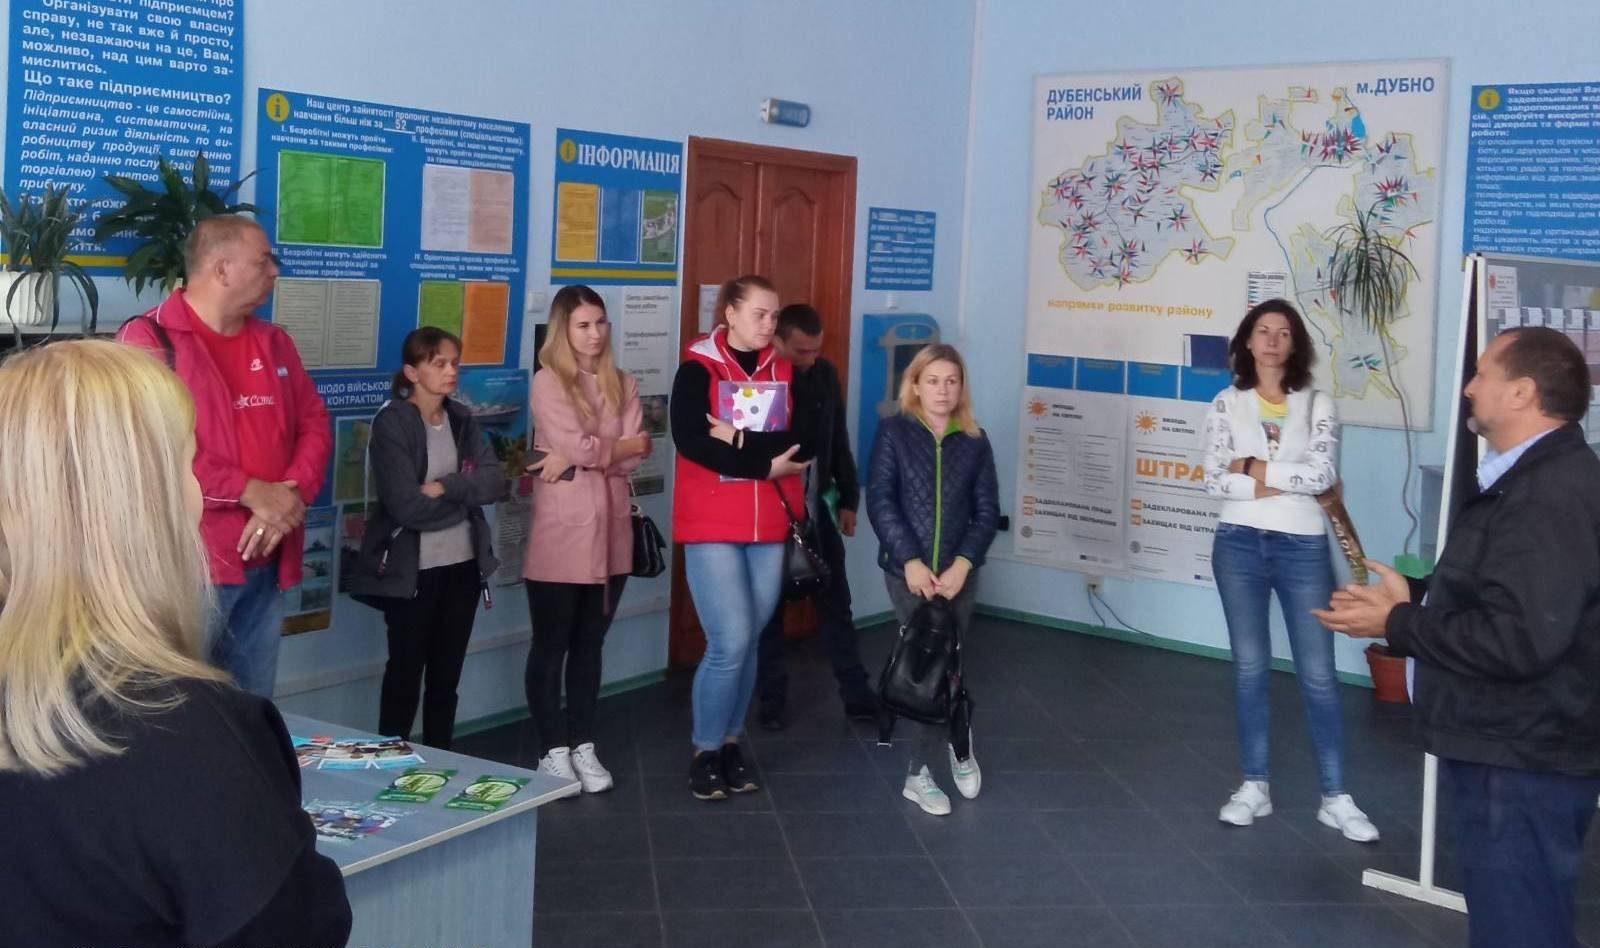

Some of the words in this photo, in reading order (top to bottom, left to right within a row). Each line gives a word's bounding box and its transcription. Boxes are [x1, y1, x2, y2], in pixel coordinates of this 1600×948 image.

[22, 9, 79, 29] справу,
[87, 19, 104, 30] не
[110, 22, 133, 34] так
[138, 26, 165, 38] вже
[170, 29, 179, 40] й
[184, 33, 234, 51] просто,
[147, 13, 182, 27] свою
[190, 20, 234, 36] власну
[22, 24, 54, 40] але,
[61, 30, 150, 50] незважаючи
[155, 43, 172, 54] на
[177, 46, 197, 60] це,
[203, 47, 234, 64] Вам,
[22, 40, 94, 60] можливо,
[102, 50, 129, 64] над
[135, 55, 163, 67] цим
[169, 59, 208, 73] варто
[213, 65, 234, 76] за-
[22, 56, 107, 75] мислитись.
[24, 69, 53, 86] Що
[56, 76, 94, 90] таке
[99, 79, 231, 105] підприємництво?
[1047, 83, 1142, 105] ДУБЕНСЬКИЙ
[23, 88, 132, 111] Підприємництво
[145, 103, 159, 115] це
[163, 105, 233, 123] самостійна,
[306, 97, 325, 109] Наш
[326, 102, 351, 114] центр
[1047, 104, 1094, 120] РАЙОН
[23, 103, 104, 124] ініціативна,
[114, 114, 210, 134] систематична,
[219, 125, 233, 135] на
[394, 119, 407, 130] 52
[21, 134, 96, 151] робництву
[22, 120, 77, 134] власний
[82, 126, 118, 137] ризик
[123, 127, 190, 145] діяльність
[195, 136, 210, 146] по
[21, 149, 64, 163] робіт,
[66, 152, 123, 166] наданню
[124, 157, 161, 171] послу
[577, 143, 680, 175] ІНФОРМАЦІЯ
[20, 164, 96, 180] торгівлею)
[347, 381, 392, 392] ВІЙСЬКОВ
[1136, 457, 1206, 483] ШТРА
[1142, 502, 1207, 517] ЗАДЕКЛАРОВАНА
[1142, 518, 1177, 529] ЗАХИЩАЄ
[1193, 526, 1216, 534] ШТРА
